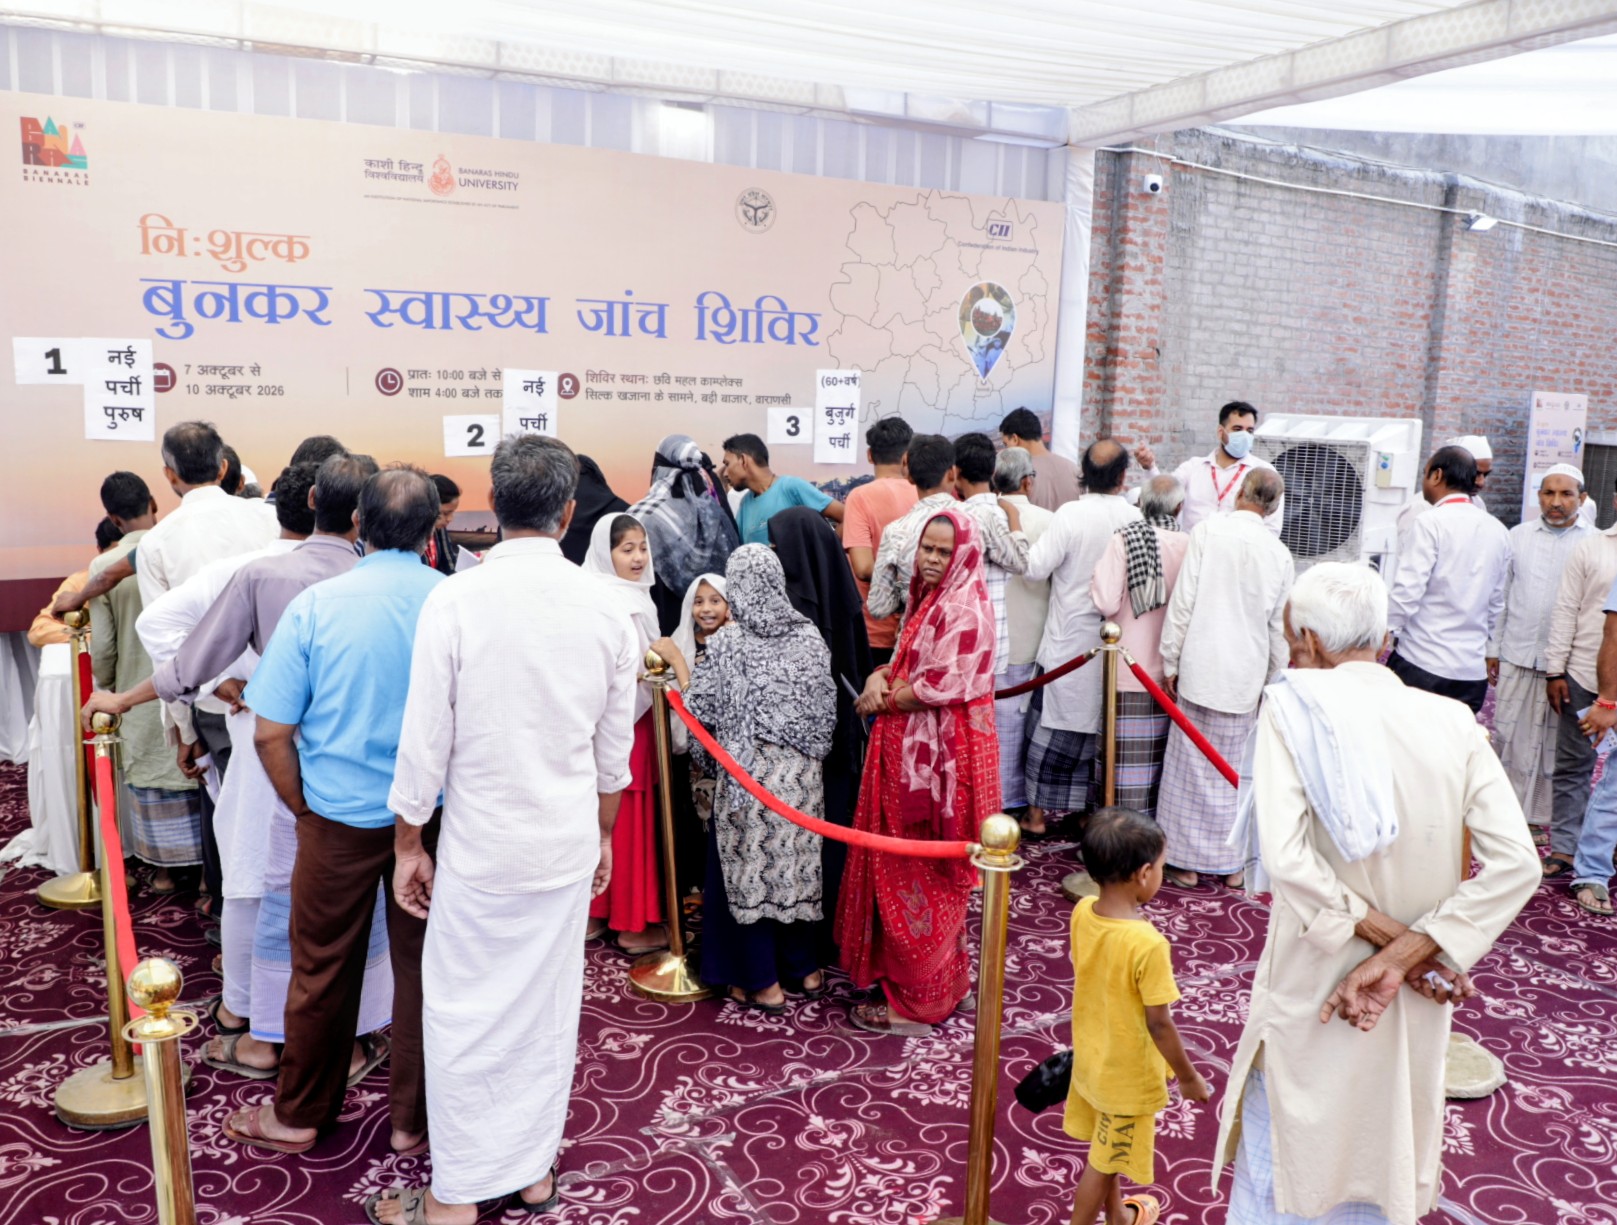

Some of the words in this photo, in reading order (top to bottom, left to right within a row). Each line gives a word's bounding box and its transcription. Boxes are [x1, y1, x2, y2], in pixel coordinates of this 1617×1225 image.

[363, 157, 394, 170] काशी
[23, 168, 88, 179] BANARAS
[23, 175, 89, 186] BIENNALE
[363, 169, 424, 184] विश्वविद्यालय
[458, 167, 492, 177] BANARAS
[494, 171, 520, 180] HINDU
[458, 177, 518, 191] UNIVERSITY
[989, 223, 1011, 237] CII
[139, 278, 333, 340] बुनकर
[363, 288, 551, 334] स्वास्थ्य
[576, 289, 670, 339] जांच
[693, 290, 822, 347] शिविर
[44, 347, 68, 375] 1
[107, 345, 137, 369] नई
[184, 364, 191, 375] 7
[197, 364, 244, 380] अक्टूबर
[249, 362, 261, 376] से
[437, 369, 464, 380] 10:00
[468, 368, 487, 380] बजे
[491, 368, 503, 381] से
[585, 369, 616, 384] शिविर
[653, 372, 671, 385] छवि
[674, 376, 697, 386] महल
[104, 375, 142, 396] पर्ची
[186, 384, 200, 395] 10
[205, 384, 252, 399] अक्टूबर
[257, 385, 285, 396] 2026
[408, 387, 431, 398] शाम
[435, 388, 457, 398] 4:00
[461, 385, 480, 398] बजे
[484, 389, 503, 399] तक
[522, 376, 546, 397] नई
[585, 387, 613, 400] सिल्क
[617, 391, 651, 401] खजाना
[654, 389, 664, 401] के
[755, 393, 792, 405] वाराणसी
[103, 406, 145, 430] पुरुष
[519, 413, 548, 431] पर्ची
[825, 403, 856, 426] बुजुर्ग
[786, 415, 801, 437] 3
[466, 423, 485, 447] 2
[828, 432, 851, 449] पर्ची
